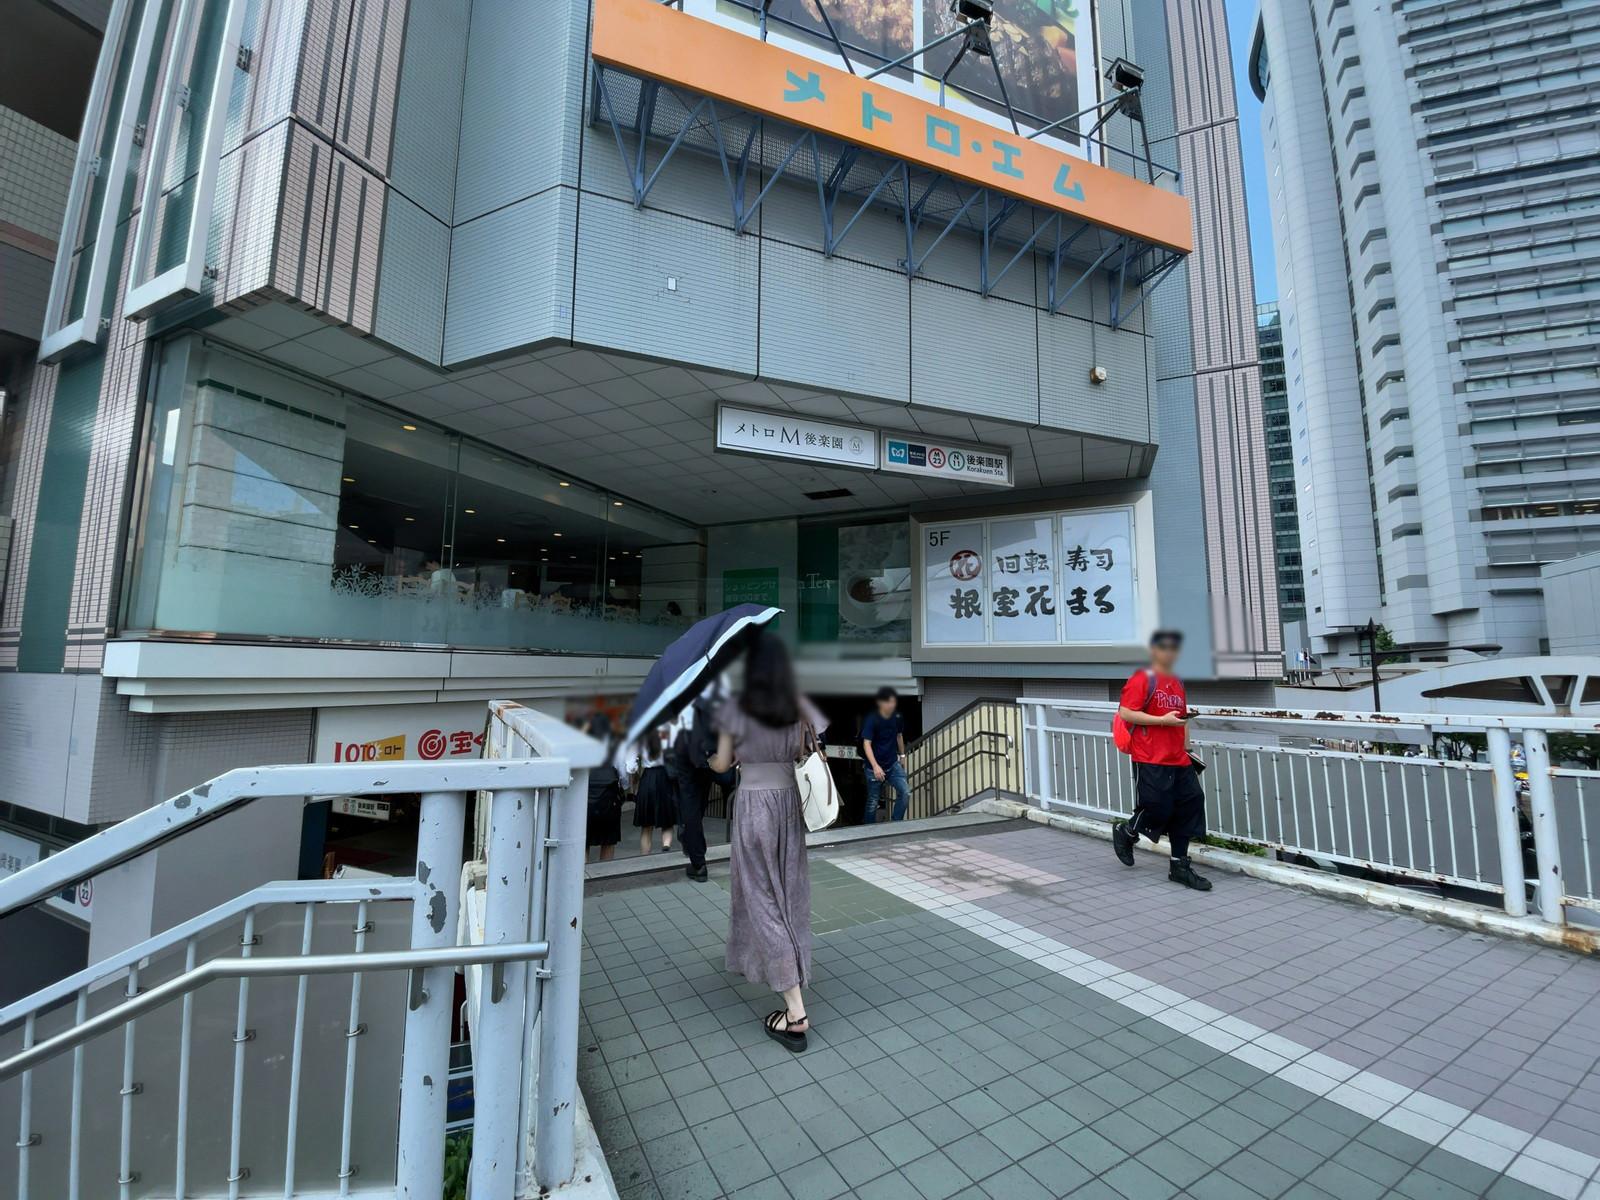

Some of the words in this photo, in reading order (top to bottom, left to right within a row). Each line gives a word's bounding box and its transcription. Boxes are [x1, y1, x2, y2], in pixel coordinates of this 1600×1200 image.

[966, 454, 1004, 470] 後楽園駅
[966, 466, 994, 475] Korakuen
[994, 469, 1005, 477] Sta.
[929, 531, 950, 547] 5F
[806, 572, 832, 589] Tea
[384, 744, 402, 756] ロト
